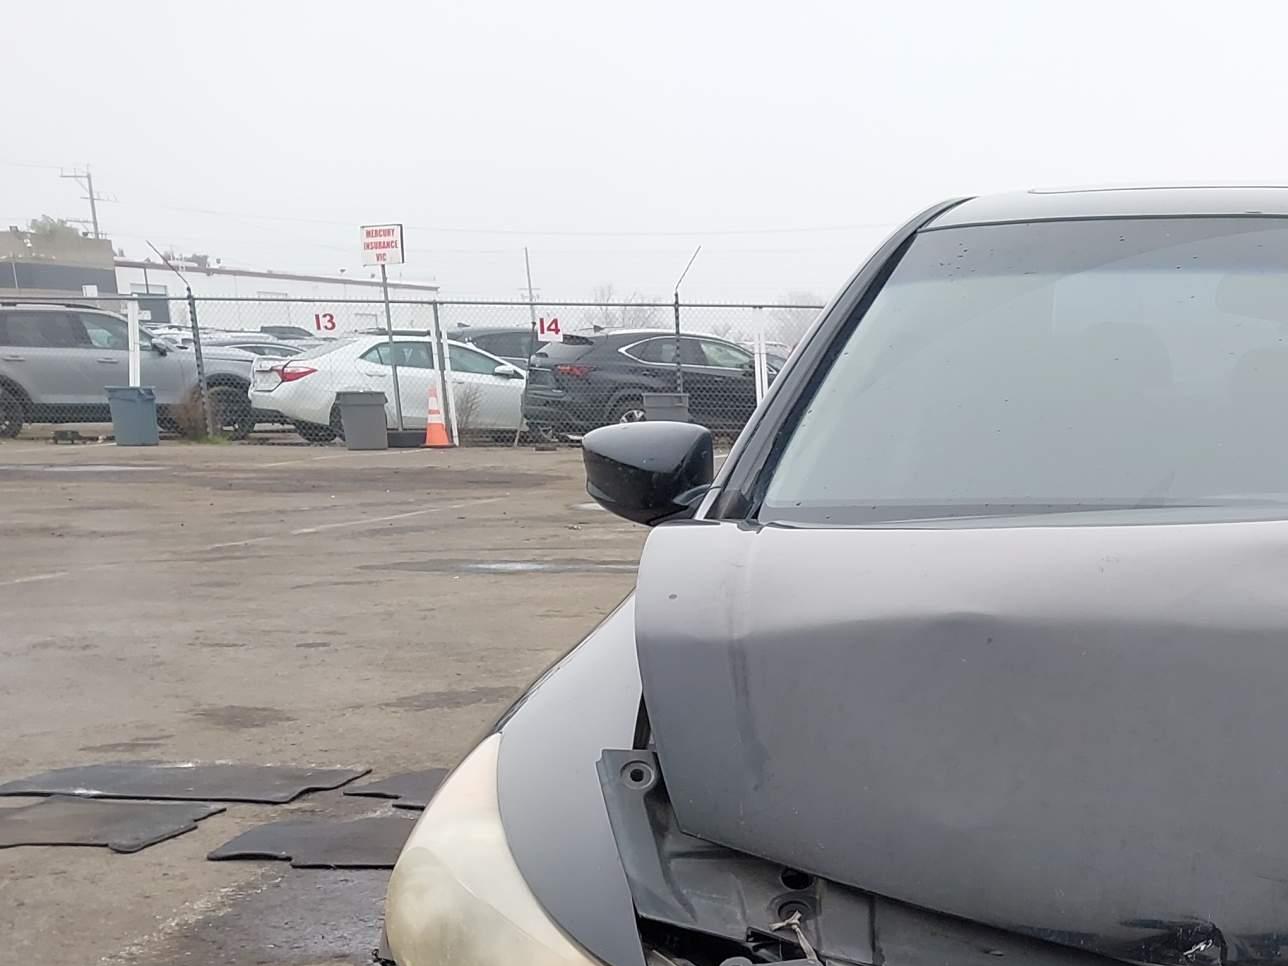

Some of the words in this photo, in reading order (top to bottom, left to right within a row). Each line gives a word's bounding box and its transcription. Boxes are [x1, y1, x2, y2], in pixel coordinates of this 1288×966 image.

[365, 228, 395, 238] MERCURY
[363, 240, 399, 250] INSURANCE
[375, 253, 387, 262] VIC
[314, 313, 336, 331] 13
[539, 318, 561, 335] 14
